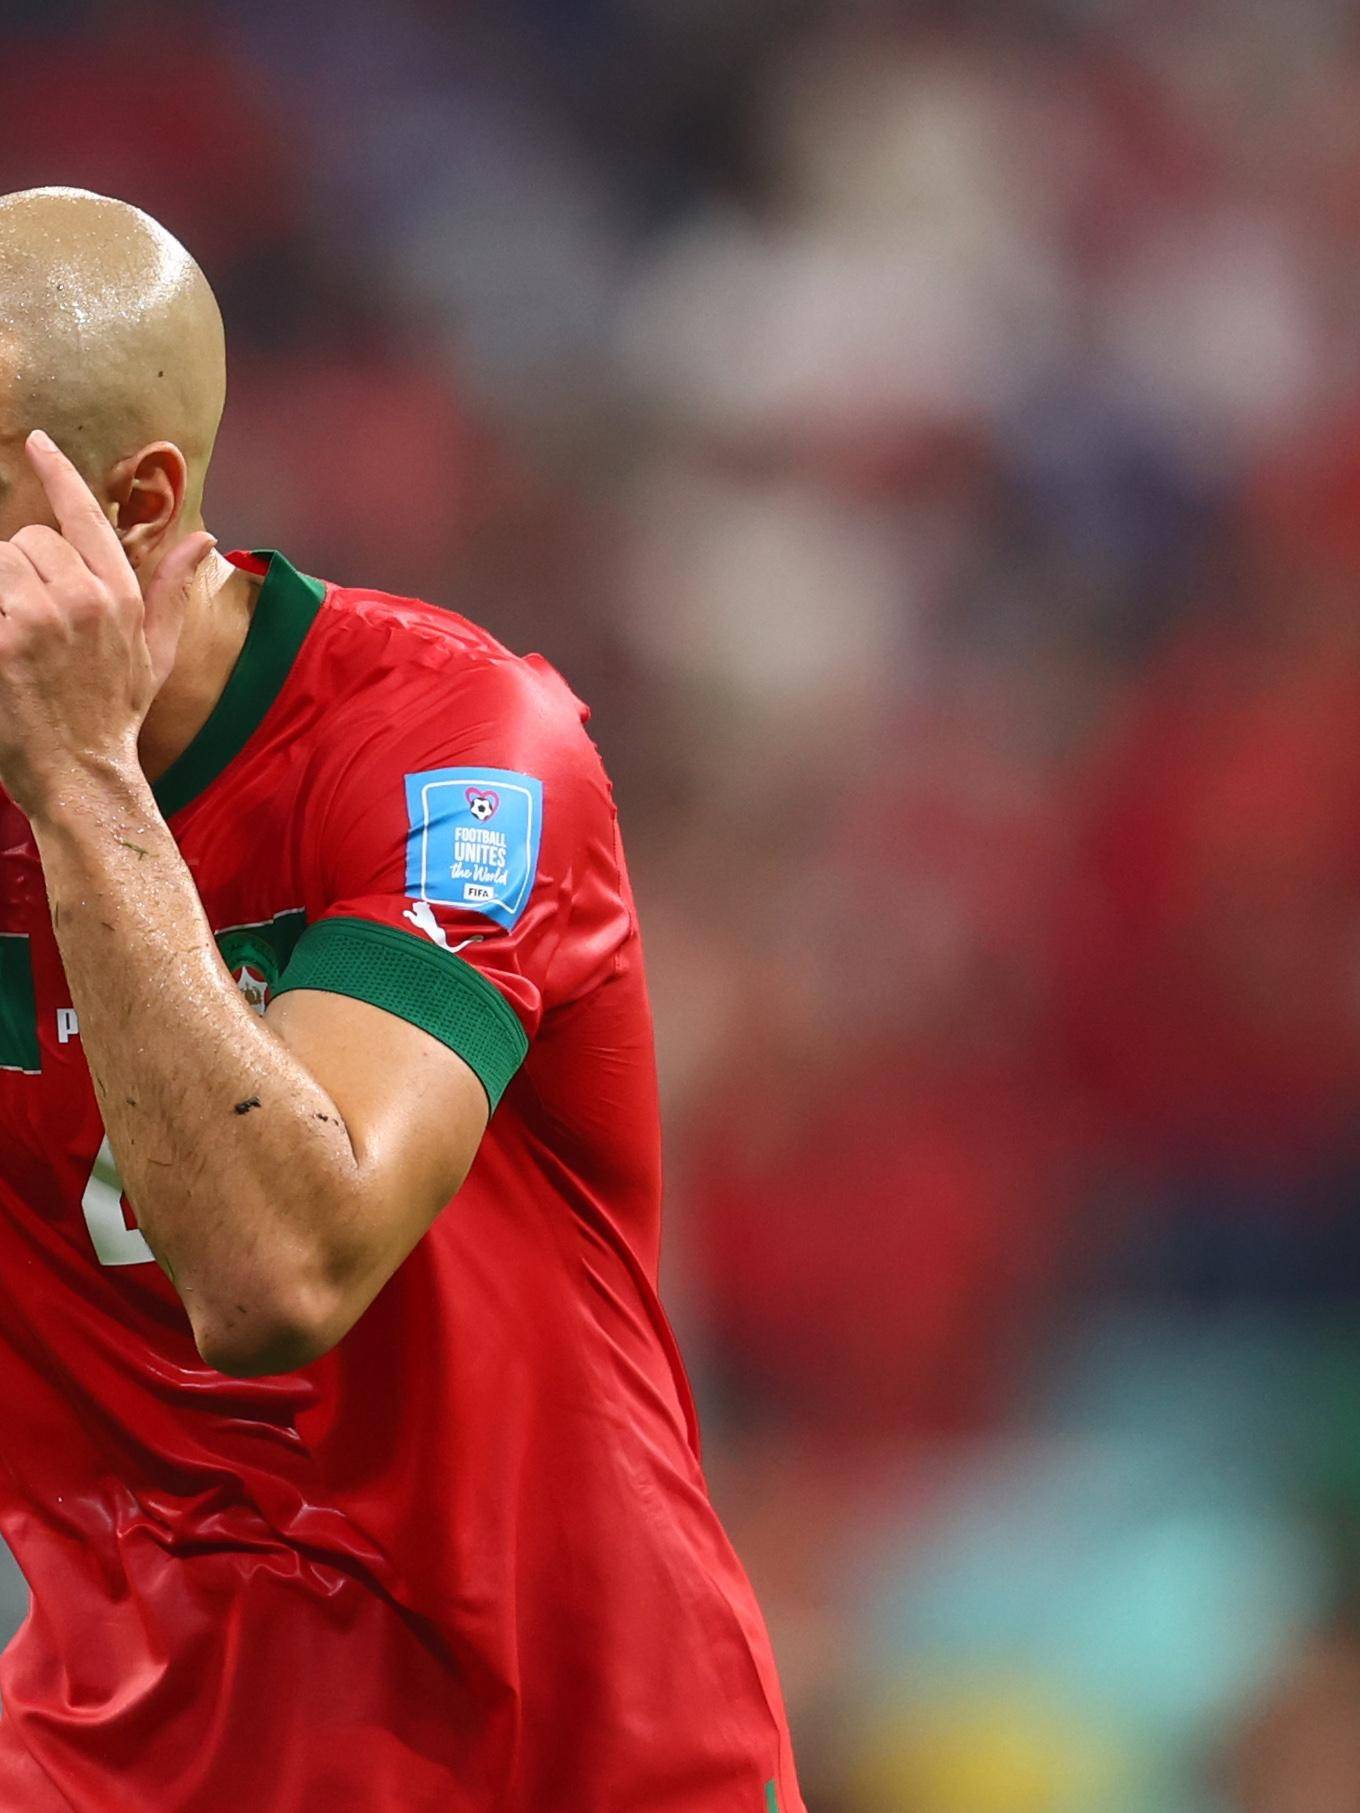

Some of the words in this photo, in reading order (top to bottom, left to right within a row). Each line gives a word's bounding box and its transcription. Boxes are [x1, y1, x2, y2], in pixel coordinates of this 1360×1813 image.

[454, 827, 507, 847] FOOTBALL
[454, 842, 507, 868] UNITES
[449, 862, 472, 879] the
[473, 864, 509, 886] World
[468, 887, 489, 898] FIFA
